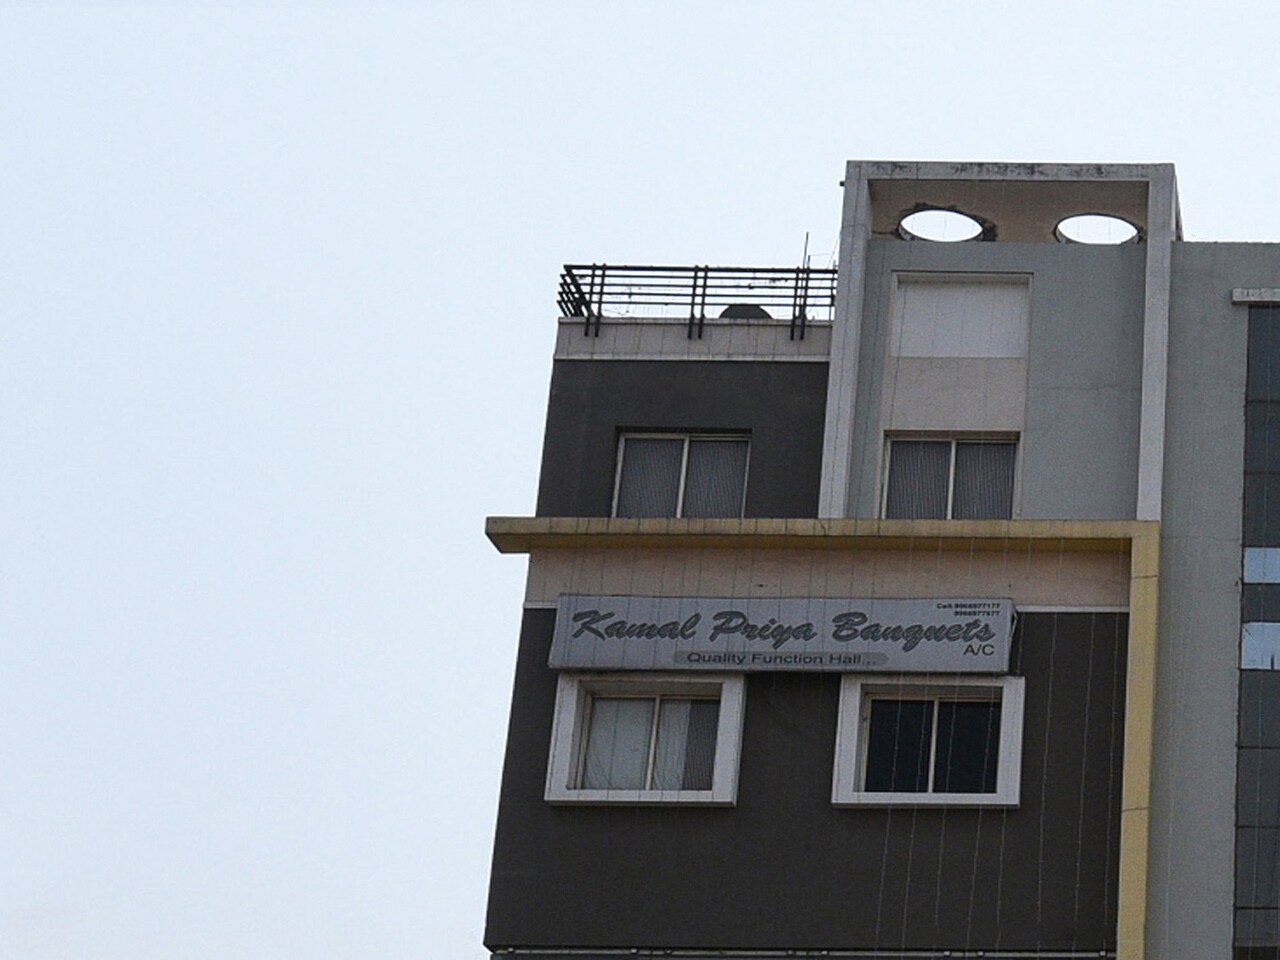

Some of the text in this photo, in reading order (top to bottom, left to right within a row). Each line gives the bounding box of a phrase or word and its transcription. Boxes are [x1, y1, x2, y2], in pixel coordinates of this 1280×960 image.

[572, 609, 996, 652] Kamal Priya Banquets
[963, 643, 995, 657] A/C
[687, 652, 746, 664] Quality
[751, 653, 823, 664] Function
